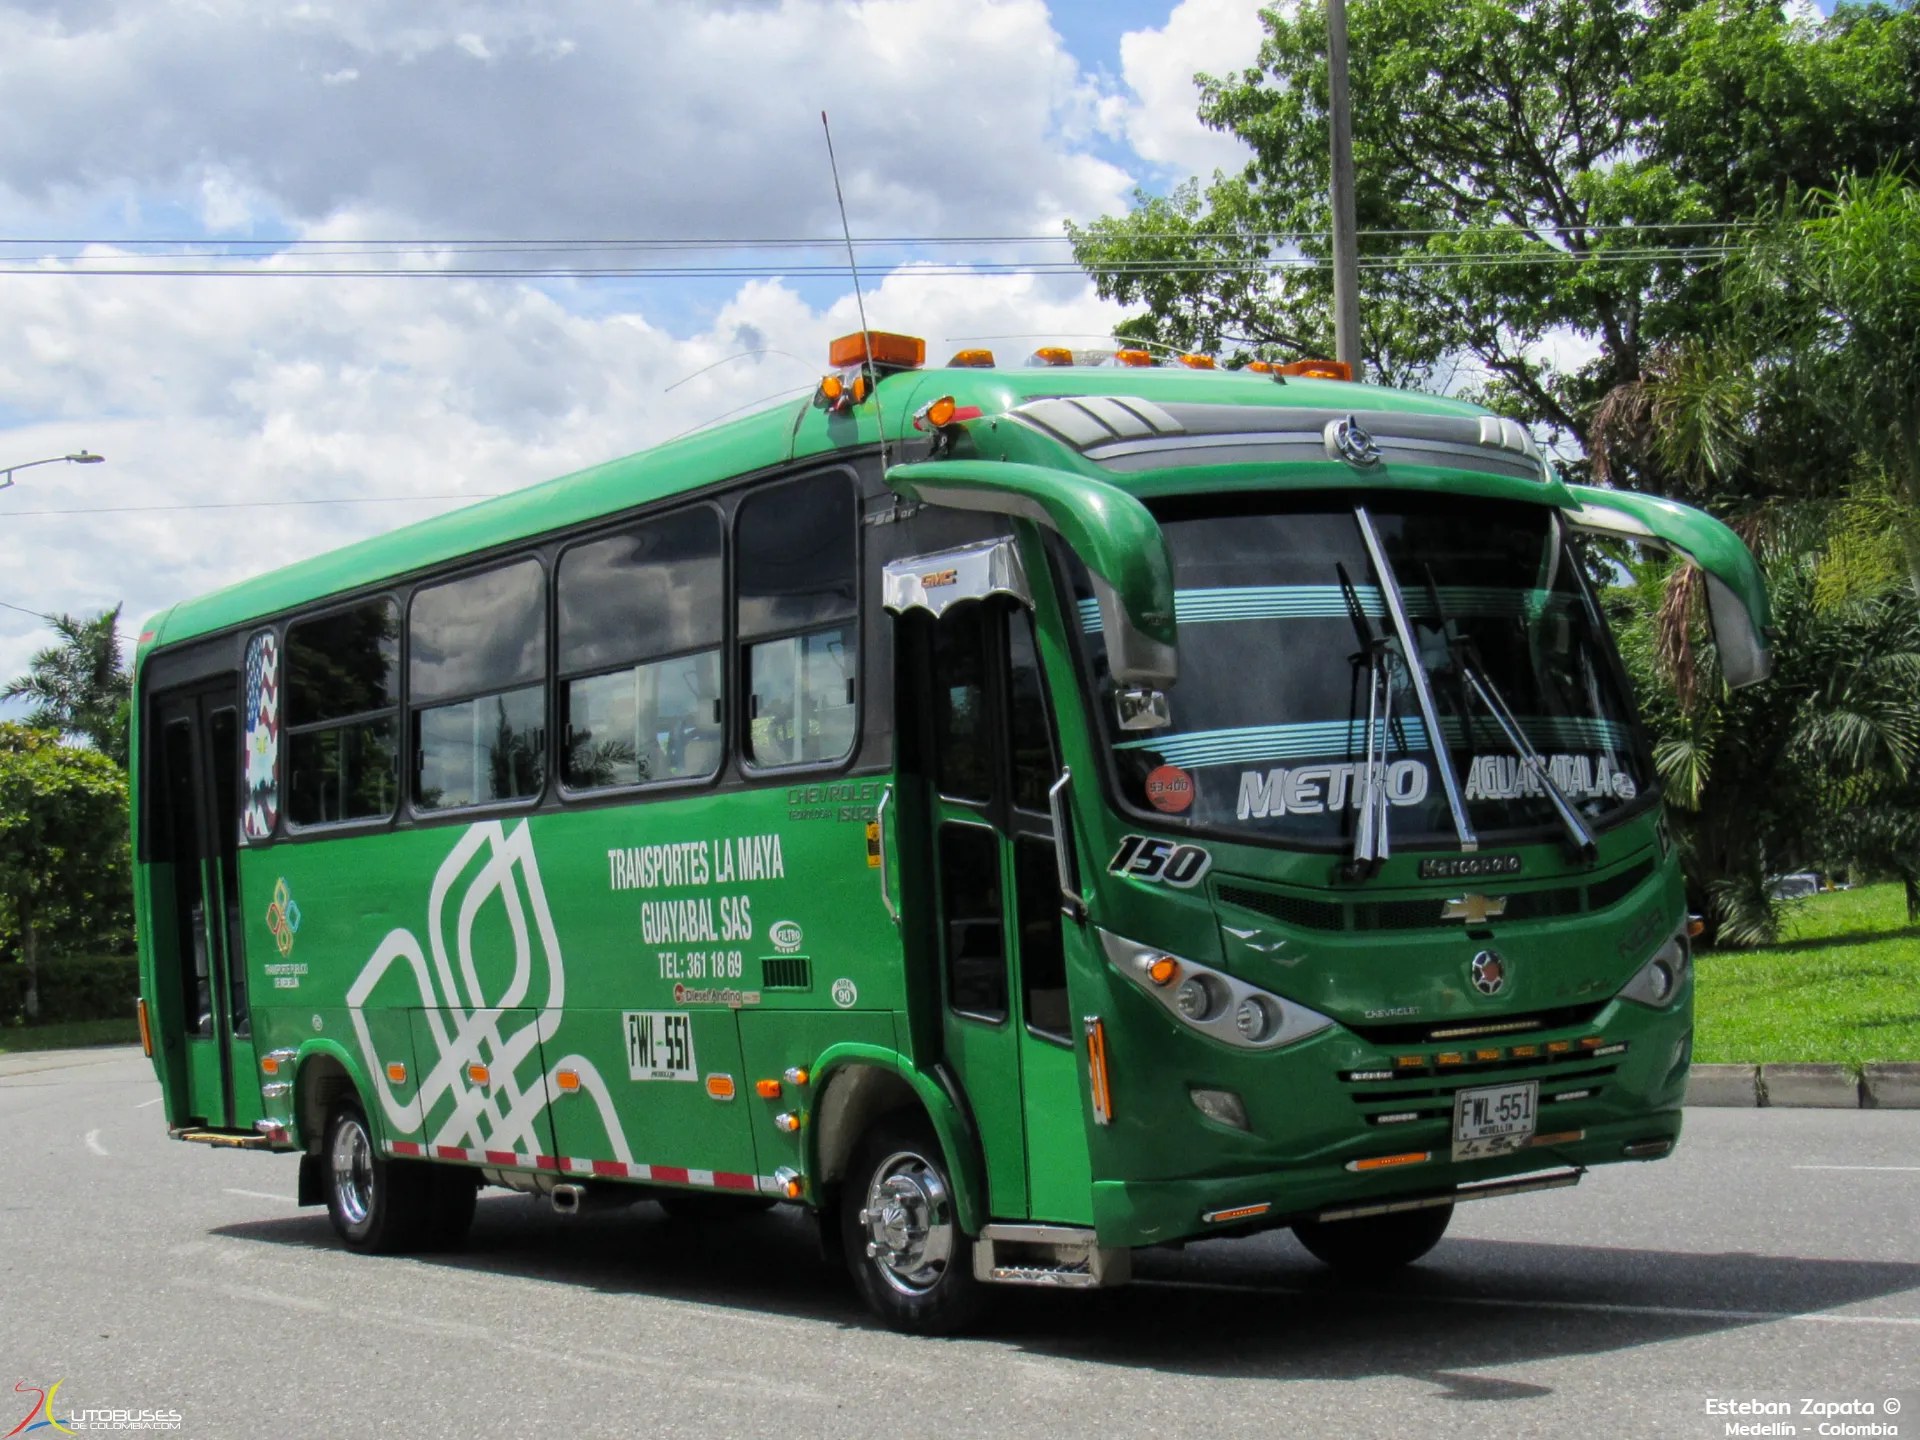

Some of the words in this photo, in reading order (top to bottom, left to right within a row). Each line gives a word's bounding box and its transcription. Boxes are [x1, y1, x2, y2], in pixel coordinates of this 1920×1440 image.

[920, 568, 957, 589] GMC
[1236, 760, 1429, 821] METRO
[607, 840, 709, 890] TRANSPORTES
[714, 838, 735, 883] LA
[737, 833, 784, 881] MAYA
[1106, 834, 1213, 889] 150
[641, 898, 718, 944] GUAYABAL
[719, 895, 752, 941] SAS
[658, 952, 685, 979] TEL:
[687, 951, 706, 979] 361
[711, 951, 725, 978] 18
[727, 950, 742, 978] 69
[838, 989, 852, 1003] 90
[628, 1014, 690, 1071] FWL-551
